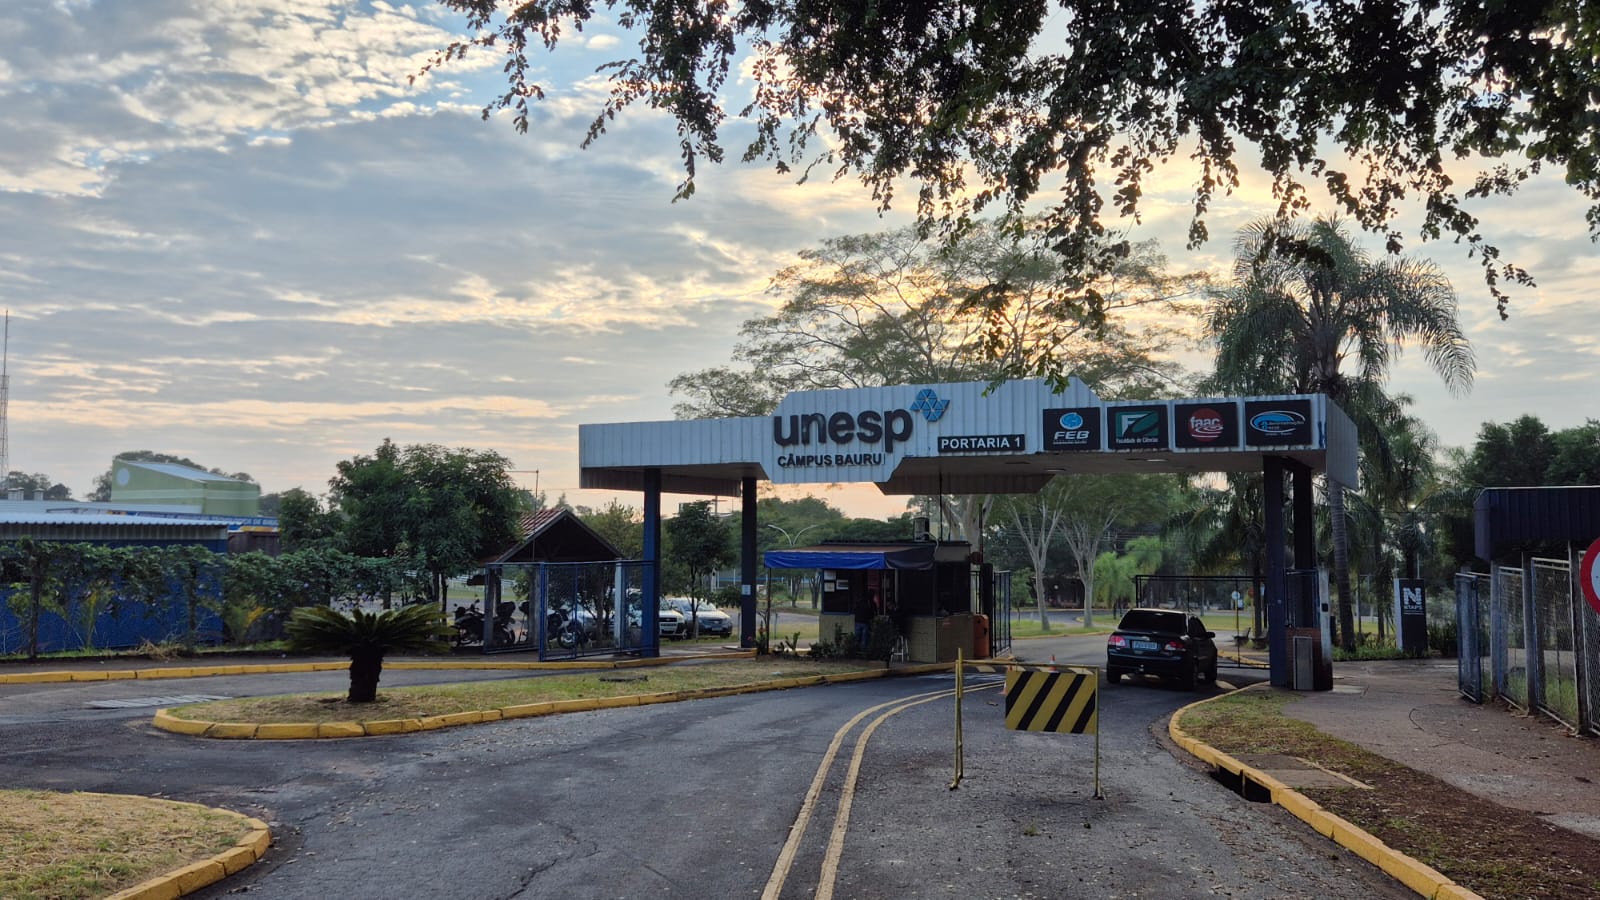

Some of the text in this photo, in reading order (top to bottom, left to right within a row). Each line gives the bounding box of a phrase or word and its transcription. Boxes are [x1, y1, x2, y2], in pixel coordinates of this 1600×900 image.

[774, 409, 914, 453] unesp
[1054, 431, 1090, 440] FEB
[941, 437, 1020, 449] PORTARIA 1
[777, 453, 881, 467] CÂMPUS BAURU
[1403, 587, 1422, 604] N
